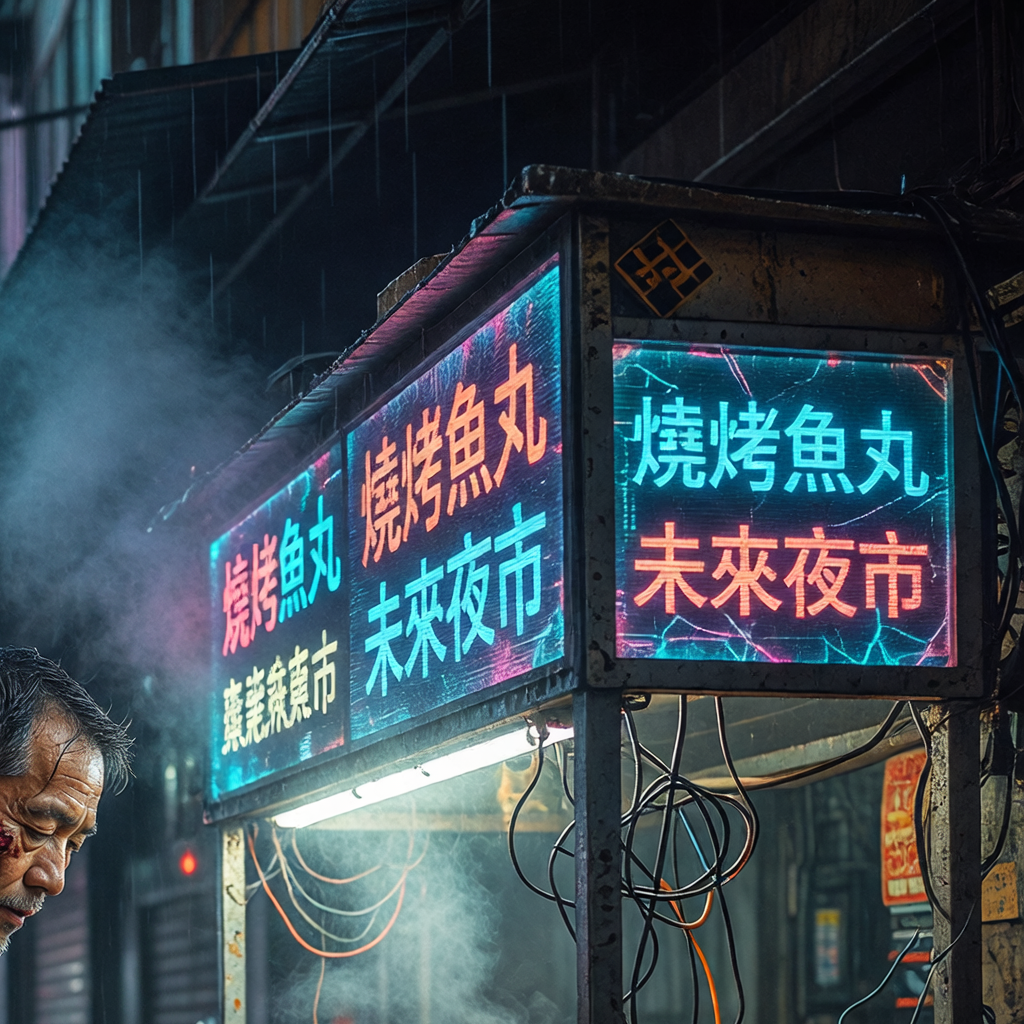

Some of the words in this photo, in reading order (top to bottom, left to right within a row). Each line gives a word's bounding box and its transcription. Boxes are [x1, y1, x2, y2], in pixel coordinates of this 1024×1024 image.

[361, 343, 547, 568] 燒烤魚丸
[632, 396, 929, 497] 燒烤魚丸
[222, 495, 342, 657] 燒烤魚丸
[365, 503, 546, 697] 未來夜市
[633, 521, 929, 619] 未來夜市
